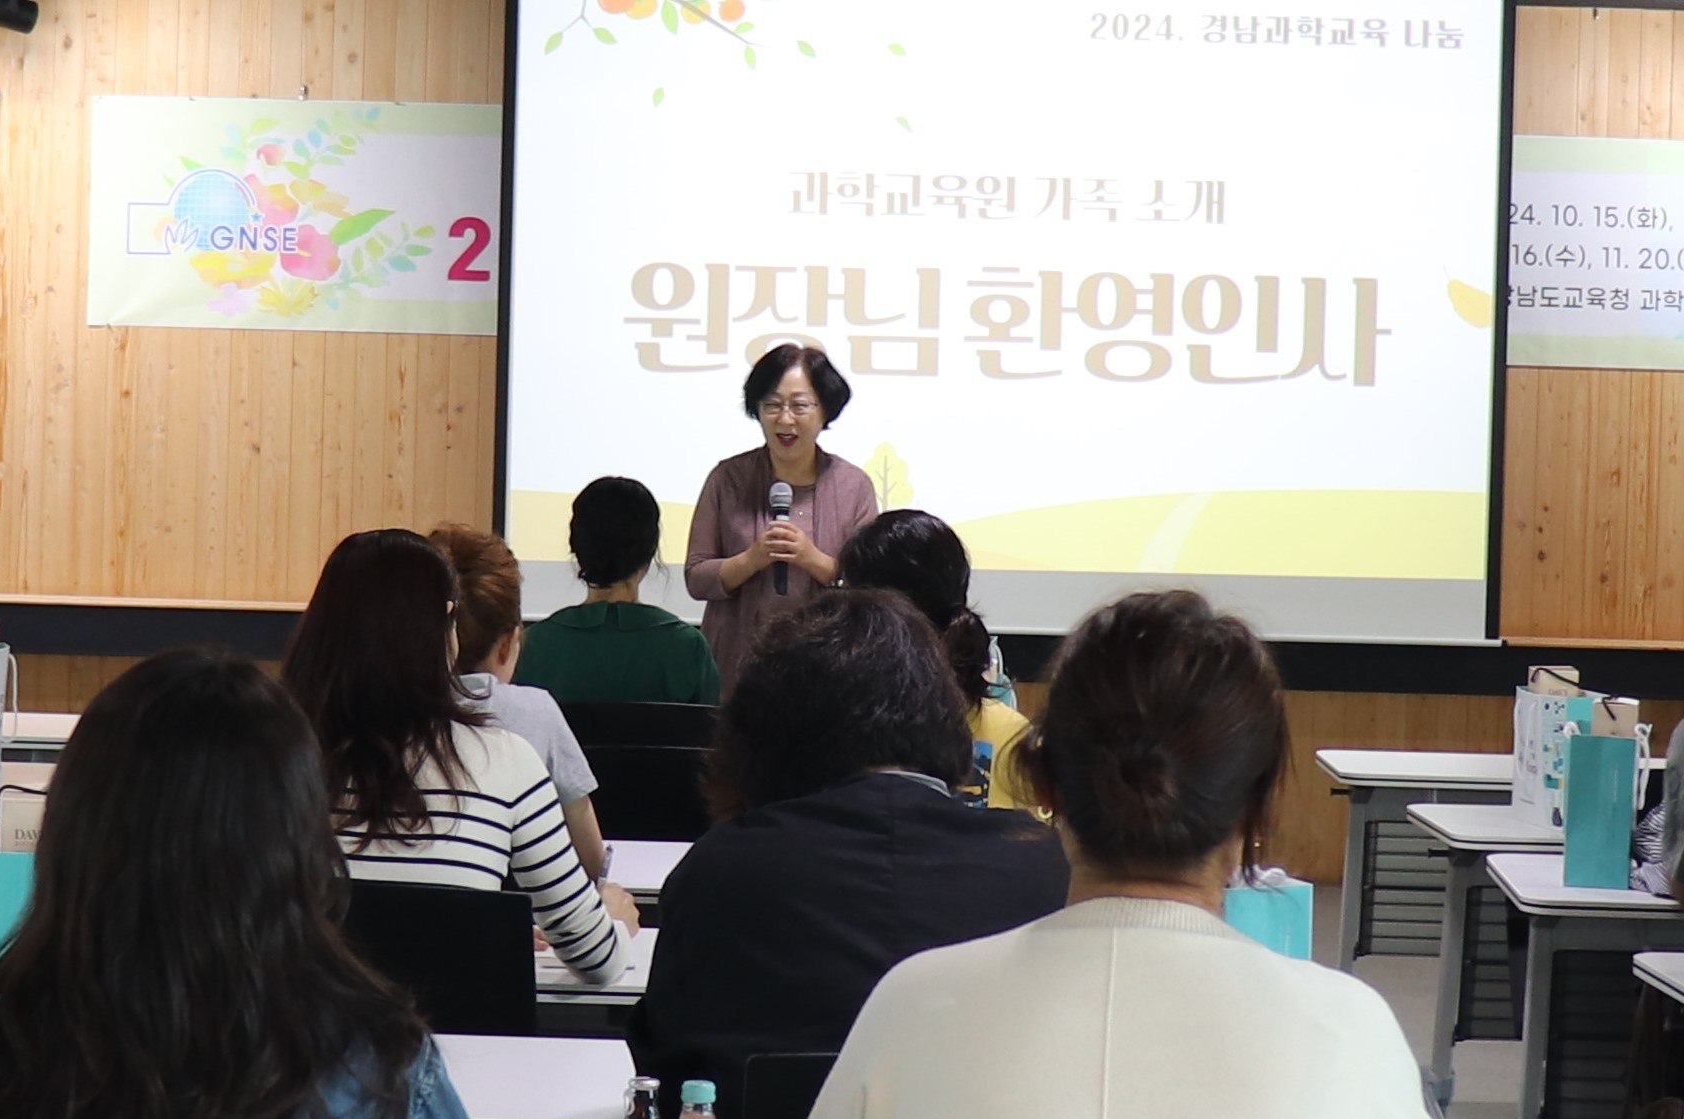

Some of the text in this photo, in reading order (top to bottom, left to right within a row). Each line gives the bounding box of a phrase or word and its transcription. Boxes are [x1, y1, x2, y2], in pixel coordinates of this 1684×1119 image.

[1090, 12, 1465, 50] 2024. 경남과학교육 나눔
[787, 171, 1226, 225] 과학교육원 가족 소개
[1551, 204, 1584, 227] 10.
[209, 225, 298, 252] GNSE
[447, 216, 492, 282] 2
[1601, 246, 1630, 270] 11.
[623, 261, 1393, 388] 원장님 환영인사
